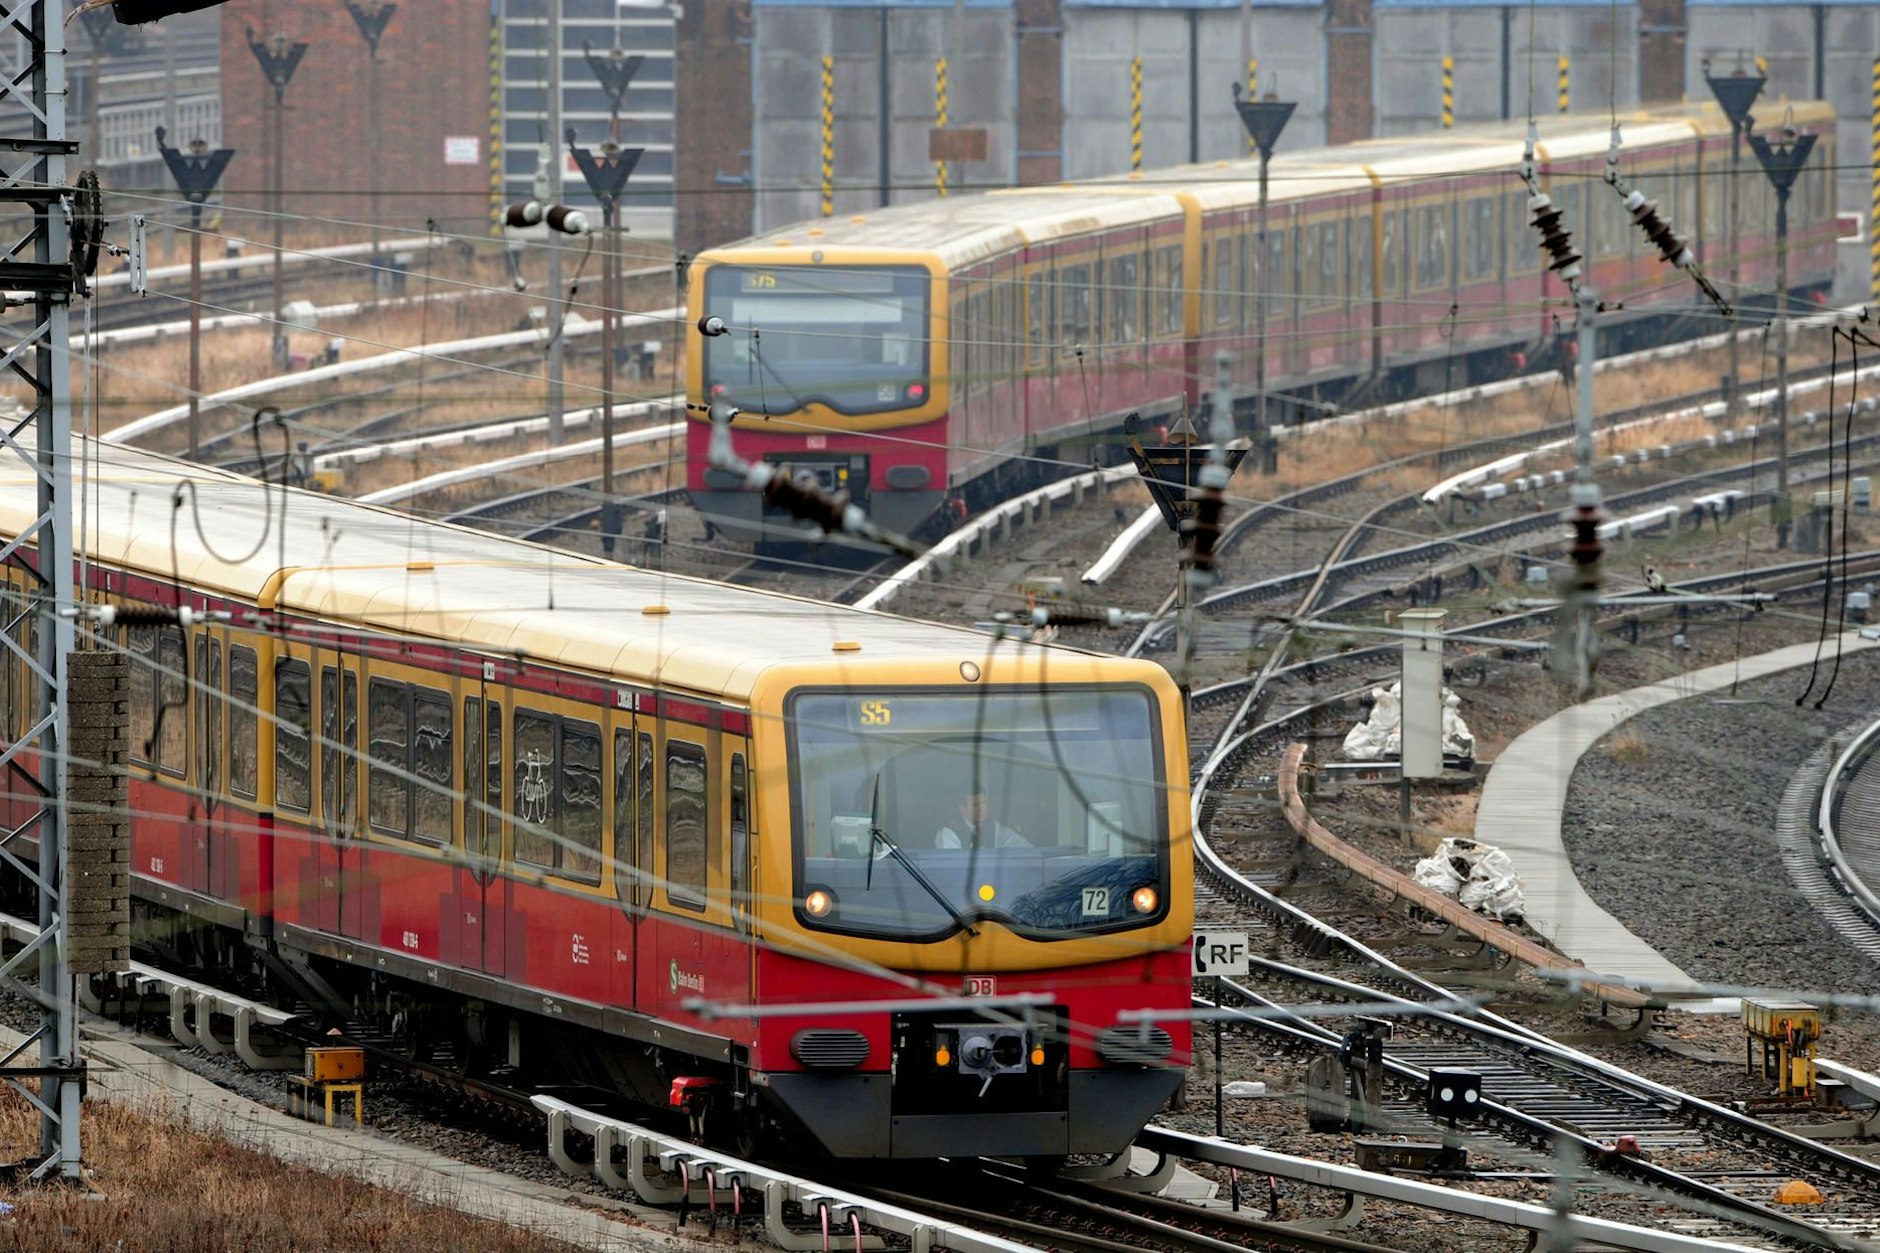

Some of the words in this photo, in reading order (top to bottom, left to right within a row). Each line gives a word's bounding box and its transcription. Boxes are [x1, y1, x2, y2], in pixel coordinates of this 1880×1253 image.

[748, 271, 777, 288] S75
[861, 700, 890, 725] S5
[1084, 890, 1107, 911] 72
[1211, 944, 1244, 964] RF
[966, 977, 994, 997] DB
